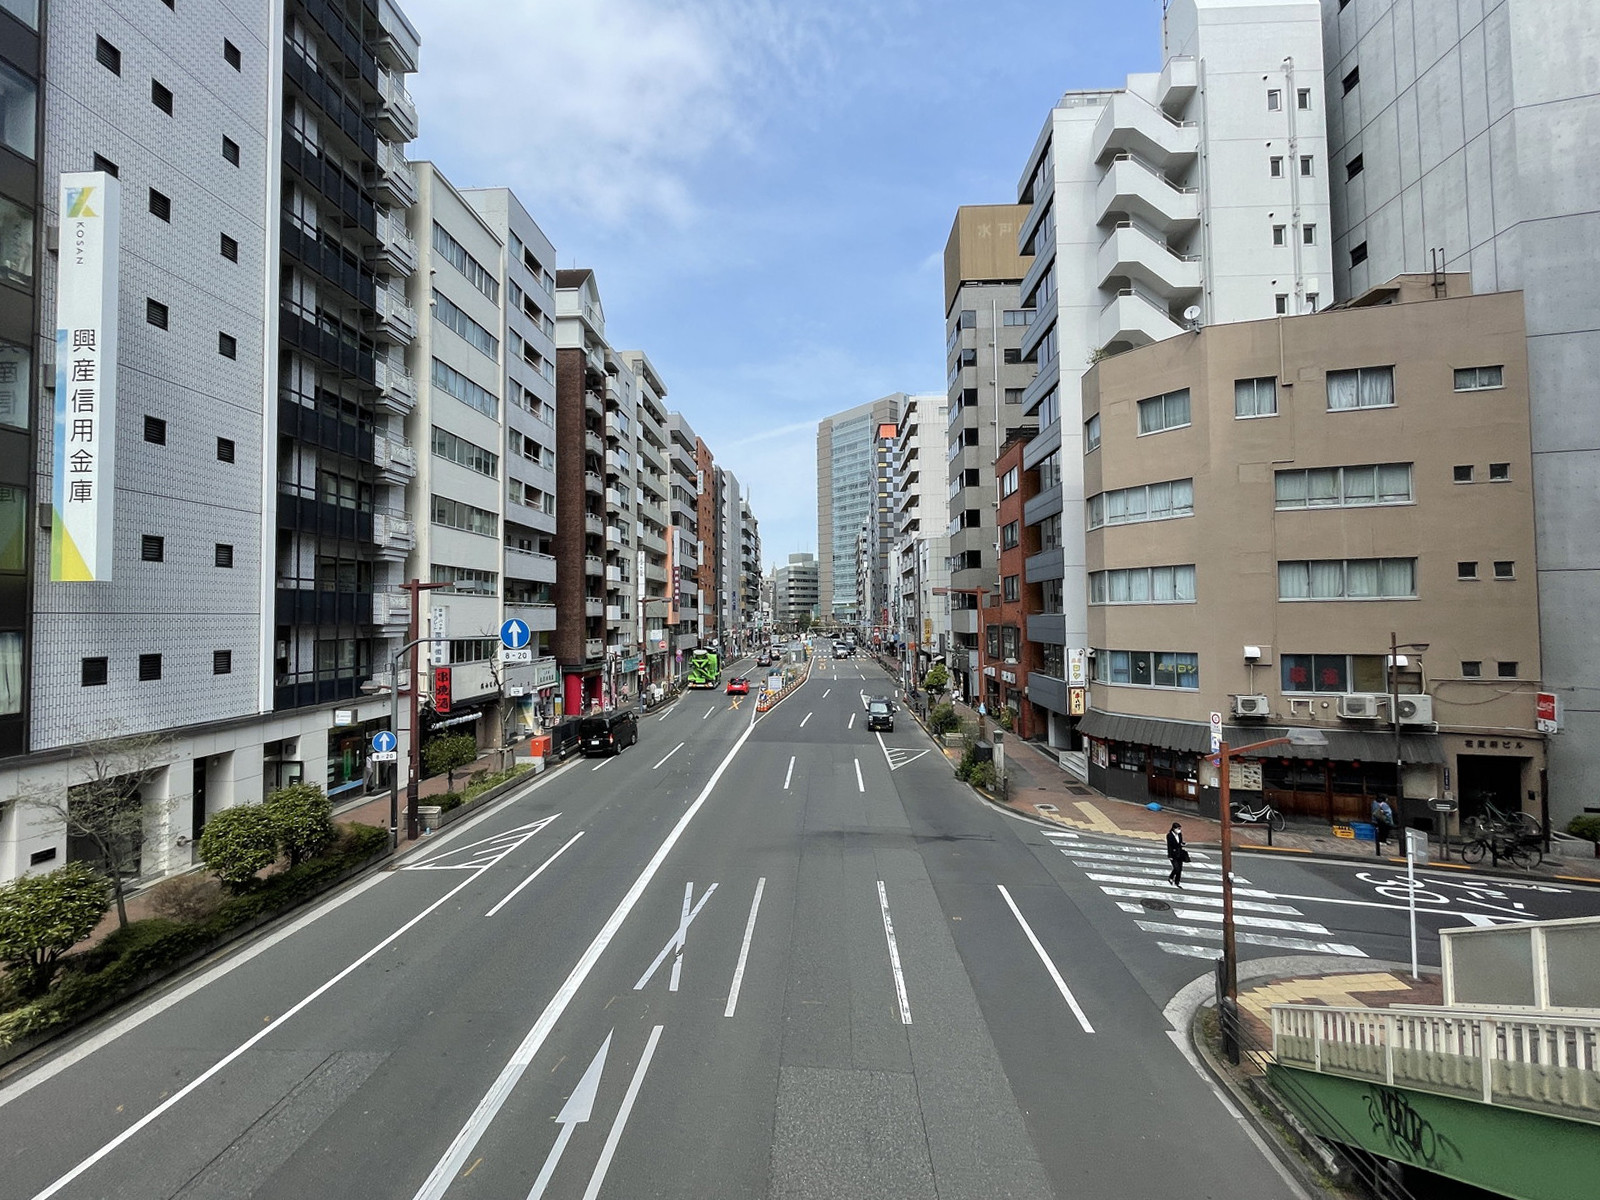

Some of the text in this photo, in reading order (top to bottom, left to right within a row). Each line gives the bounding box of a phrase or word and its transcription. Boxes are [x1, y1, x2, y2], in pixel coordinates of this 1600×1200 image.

[75, 221, 85, 266] KOSAN
[977, 222, 1024, 238] 水戸
[68, 328, 97, 504] 興産信用金庫
[505, 652, 527, 660] 8-20
